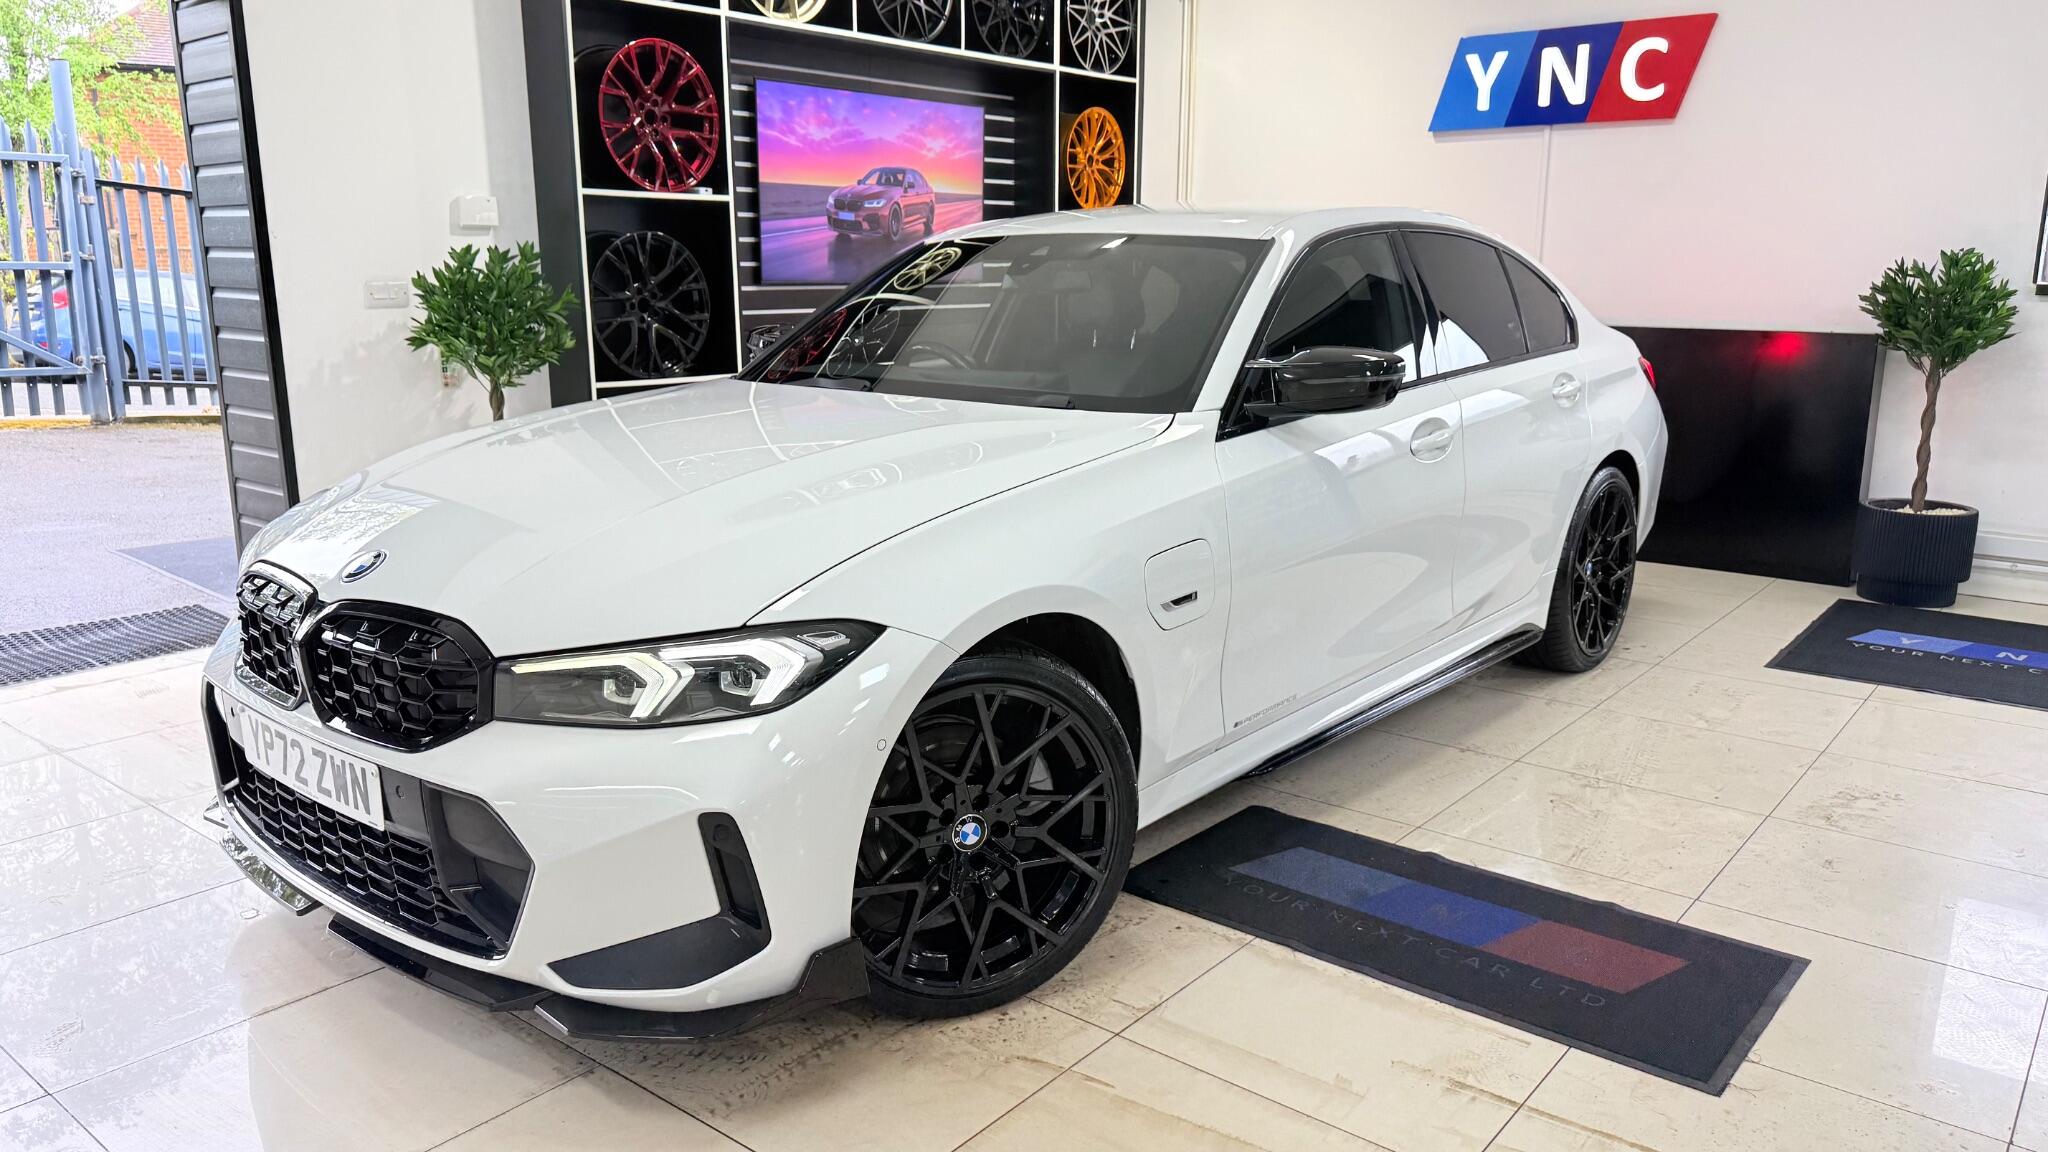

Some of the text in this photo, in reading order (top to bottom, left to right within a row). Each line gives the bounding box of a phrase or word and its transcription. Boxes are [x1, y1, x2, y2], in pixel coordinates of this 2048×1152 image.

[1465, 36, 1669, 111] YNC
[1852, 642, 1924, 657] YOUR
[1940, 655, 2013, 670] NEXT
[248, 714, 371, 816] YP72 ZWN
[1222, 874, 1310, 911] YOUR
[1435, 948, 1510, 978] CAR
[1528, 977, 1606, 1008] LTD
